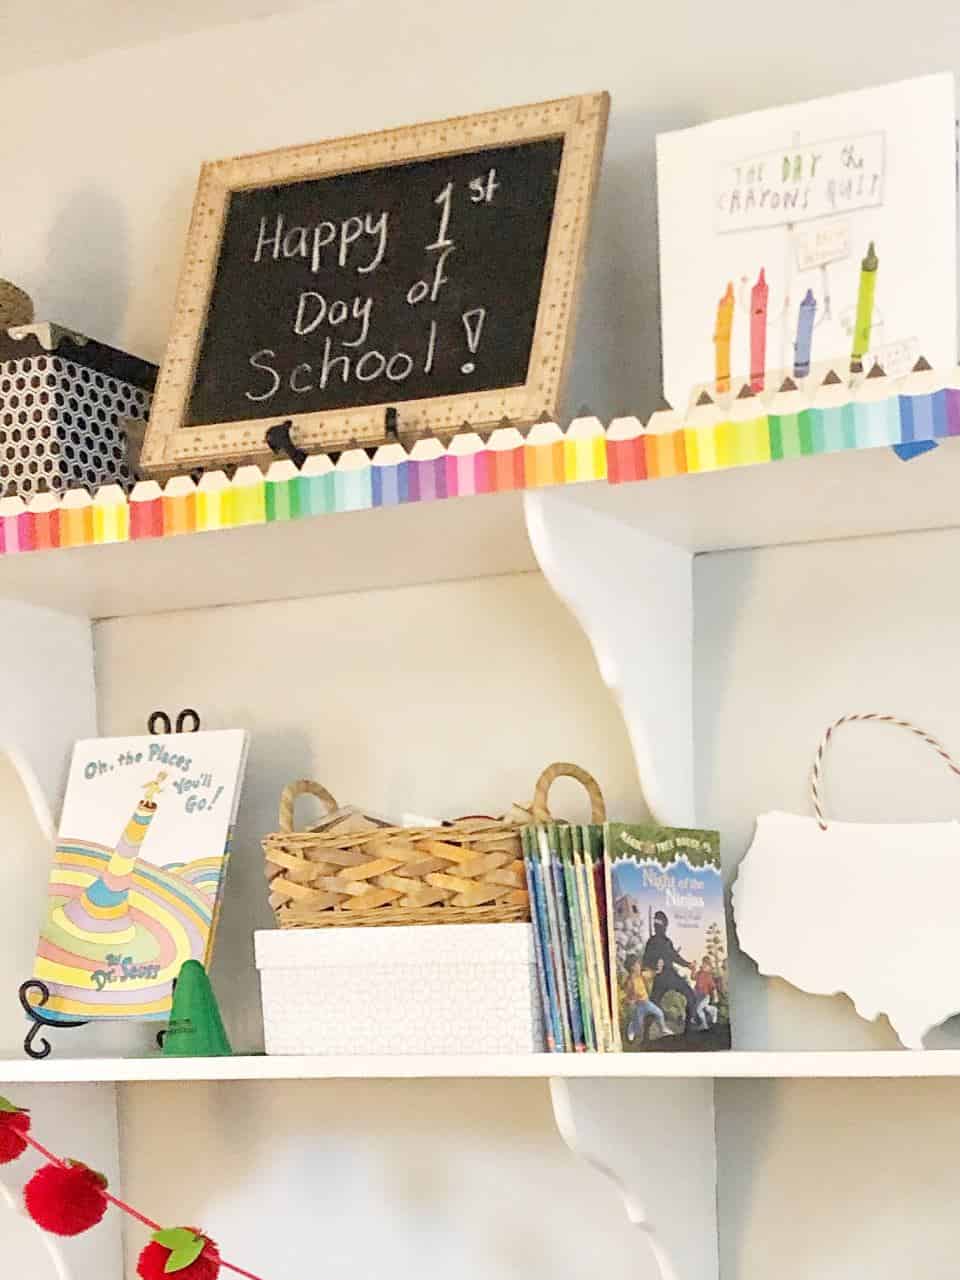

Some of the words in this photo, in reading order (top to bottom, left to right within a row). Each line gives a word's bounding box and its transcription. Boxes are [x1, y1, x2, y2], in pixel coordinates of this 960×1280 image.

[782, 153, 822, 184] DAY
[718, 188, 811, 215] CRAYONS
[254, 209, 388, 273] Happy
[294, 291, 373, 347] Day
[407, 247, 455, 304] of
[117, 750, 143, 767] the
[147, 743, 193, 772] Places
[173, 773, 213, 795] You'll
[184, 785, 225, 814] Go!
[642, 868, 676, 893] Night
